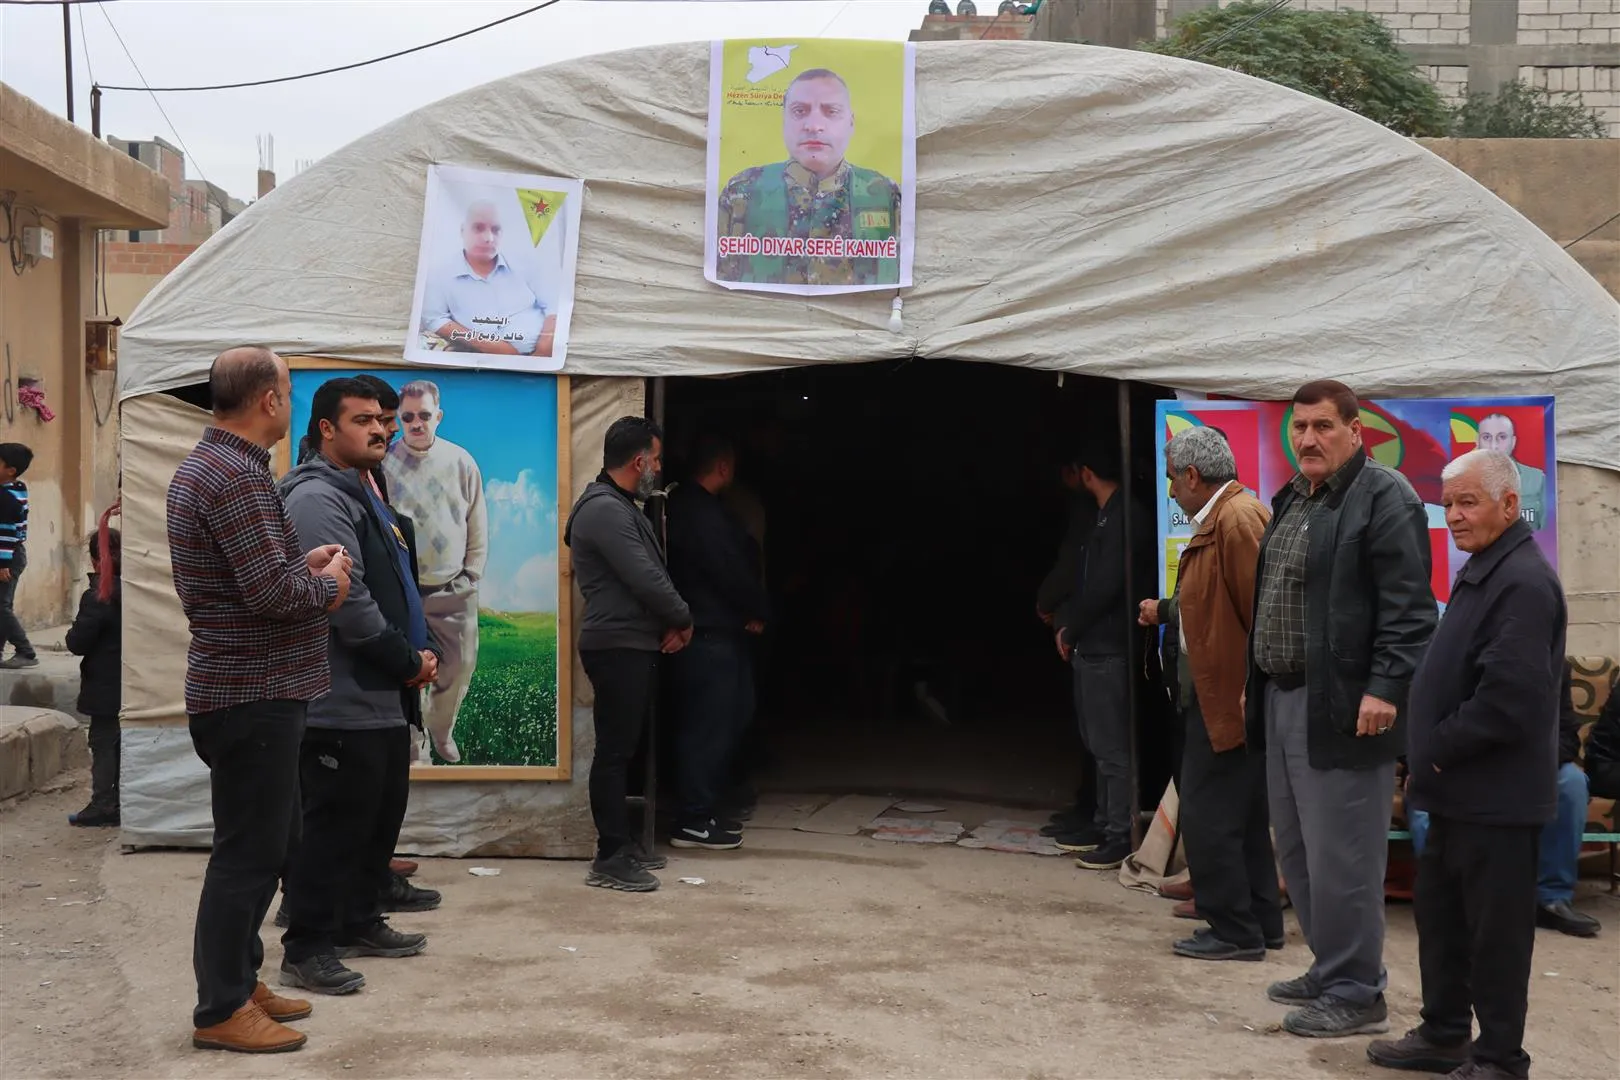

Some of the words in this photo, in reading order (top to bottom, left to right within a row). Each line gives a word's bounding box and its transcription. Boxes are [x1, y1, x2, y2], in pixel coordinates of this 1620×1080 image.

[719, 234, 759, 257] ŞEHÎD
[763, 237, 804, 256] DIYAR
[806, 235, 842, 256] SERÊ
[846, 236, 896, 257] KANIYÊ
[472, 316, 508, 326] الشهيد
[503, 331, 524, 341] خالد
